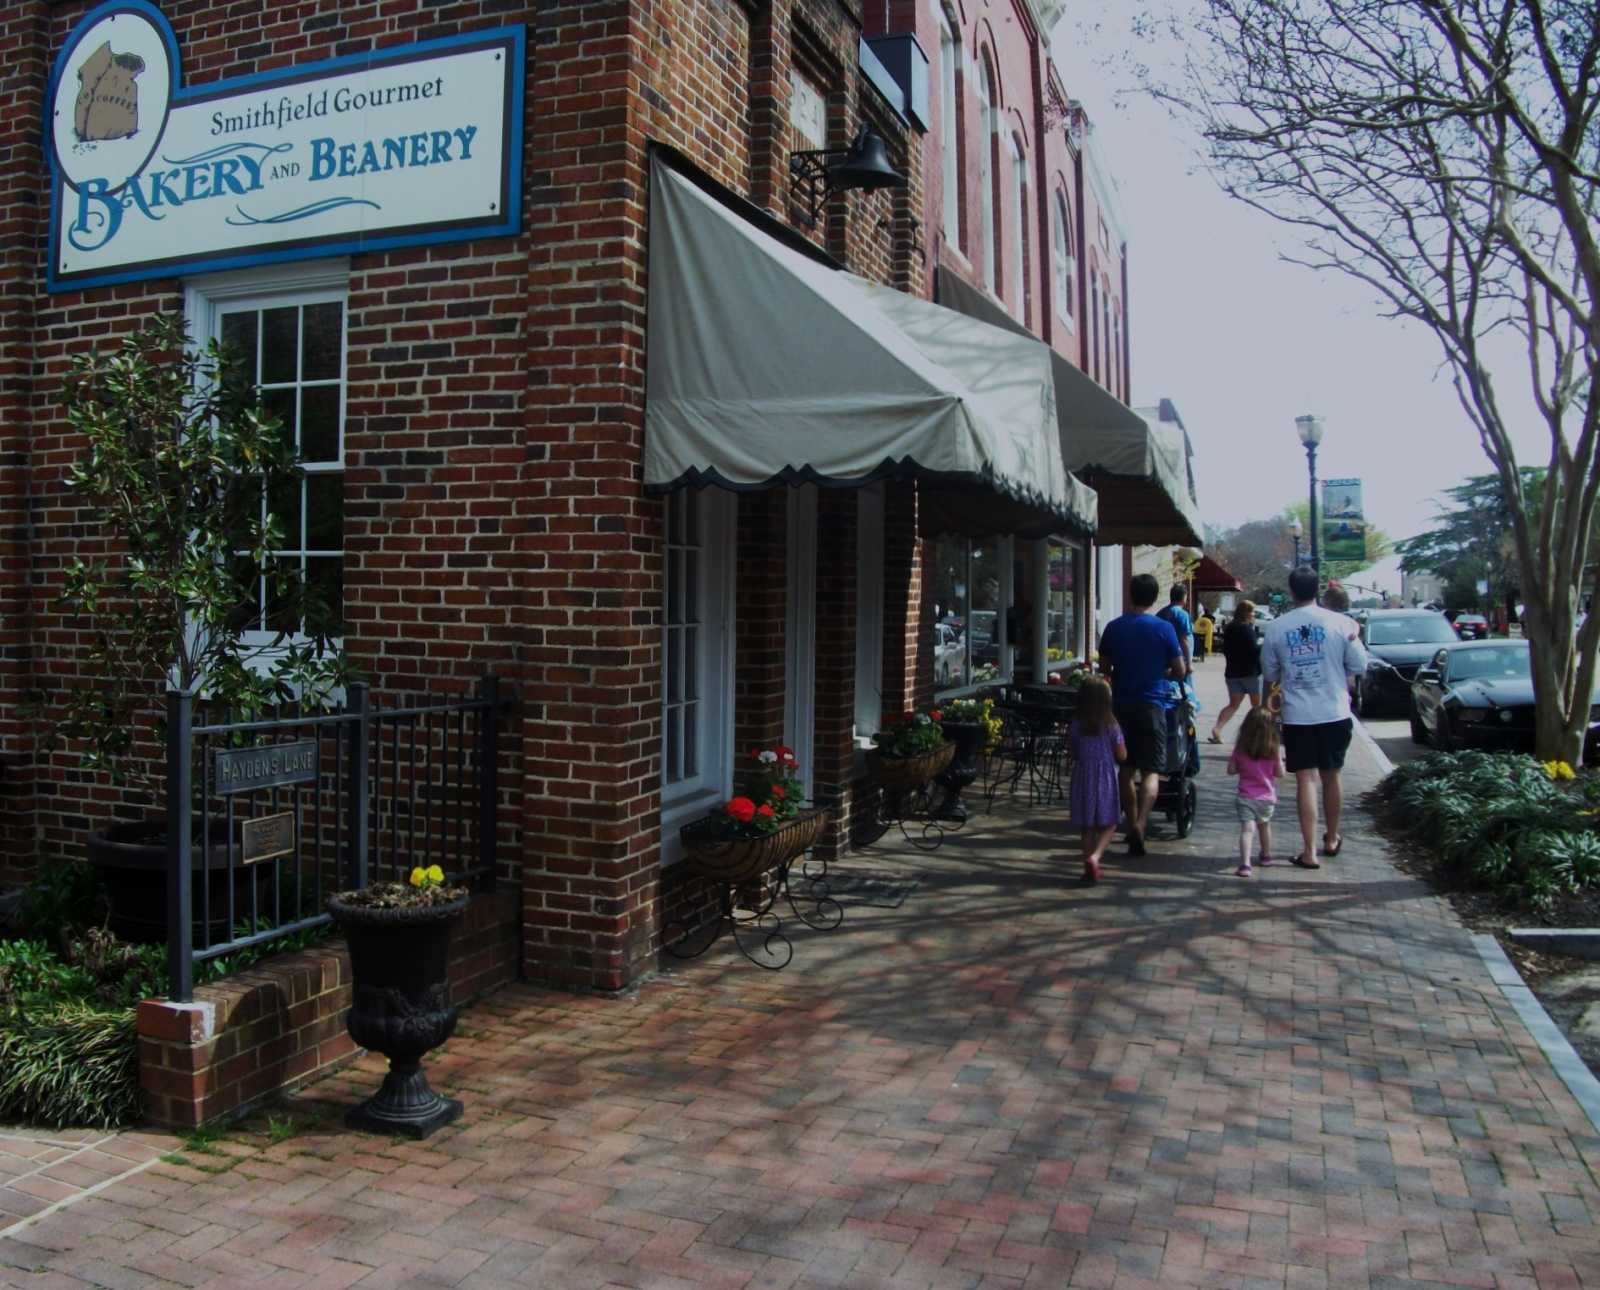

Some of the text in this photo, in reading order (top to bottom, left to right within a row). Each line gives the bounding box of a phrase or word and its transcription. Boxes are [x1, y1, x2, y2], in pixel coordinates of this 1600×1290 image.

[210, 77, 444, 136] Smithfield Gourmet
[68, 125, 477, 252] BAKERY AND BEANERY
[284, 751, 313, 772] LANE
